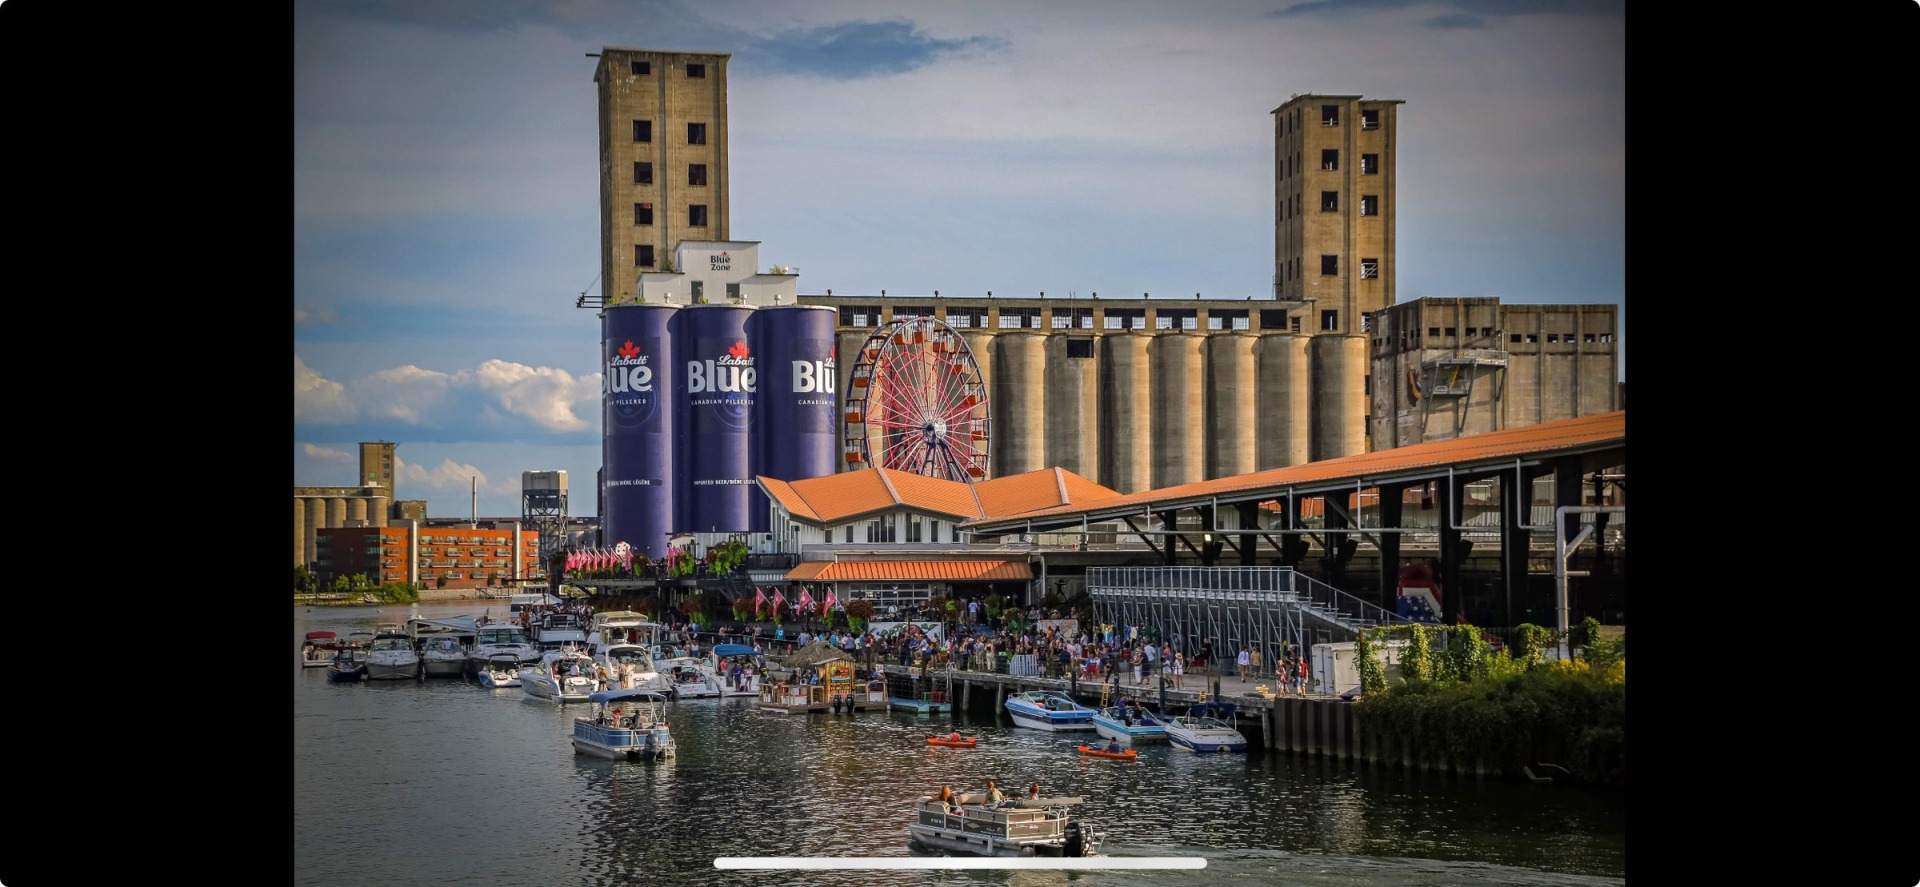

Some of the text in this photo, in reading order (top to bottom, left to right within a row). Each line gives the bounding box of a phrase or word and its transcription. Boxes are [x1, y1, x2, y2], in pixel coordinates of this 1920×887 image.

[611, 355, 647, 366] Labatt
[716, 354, 754, 366] Labatt
[688, 359, 757, 394] Blue
[791, 360, 835, 394] Blu
